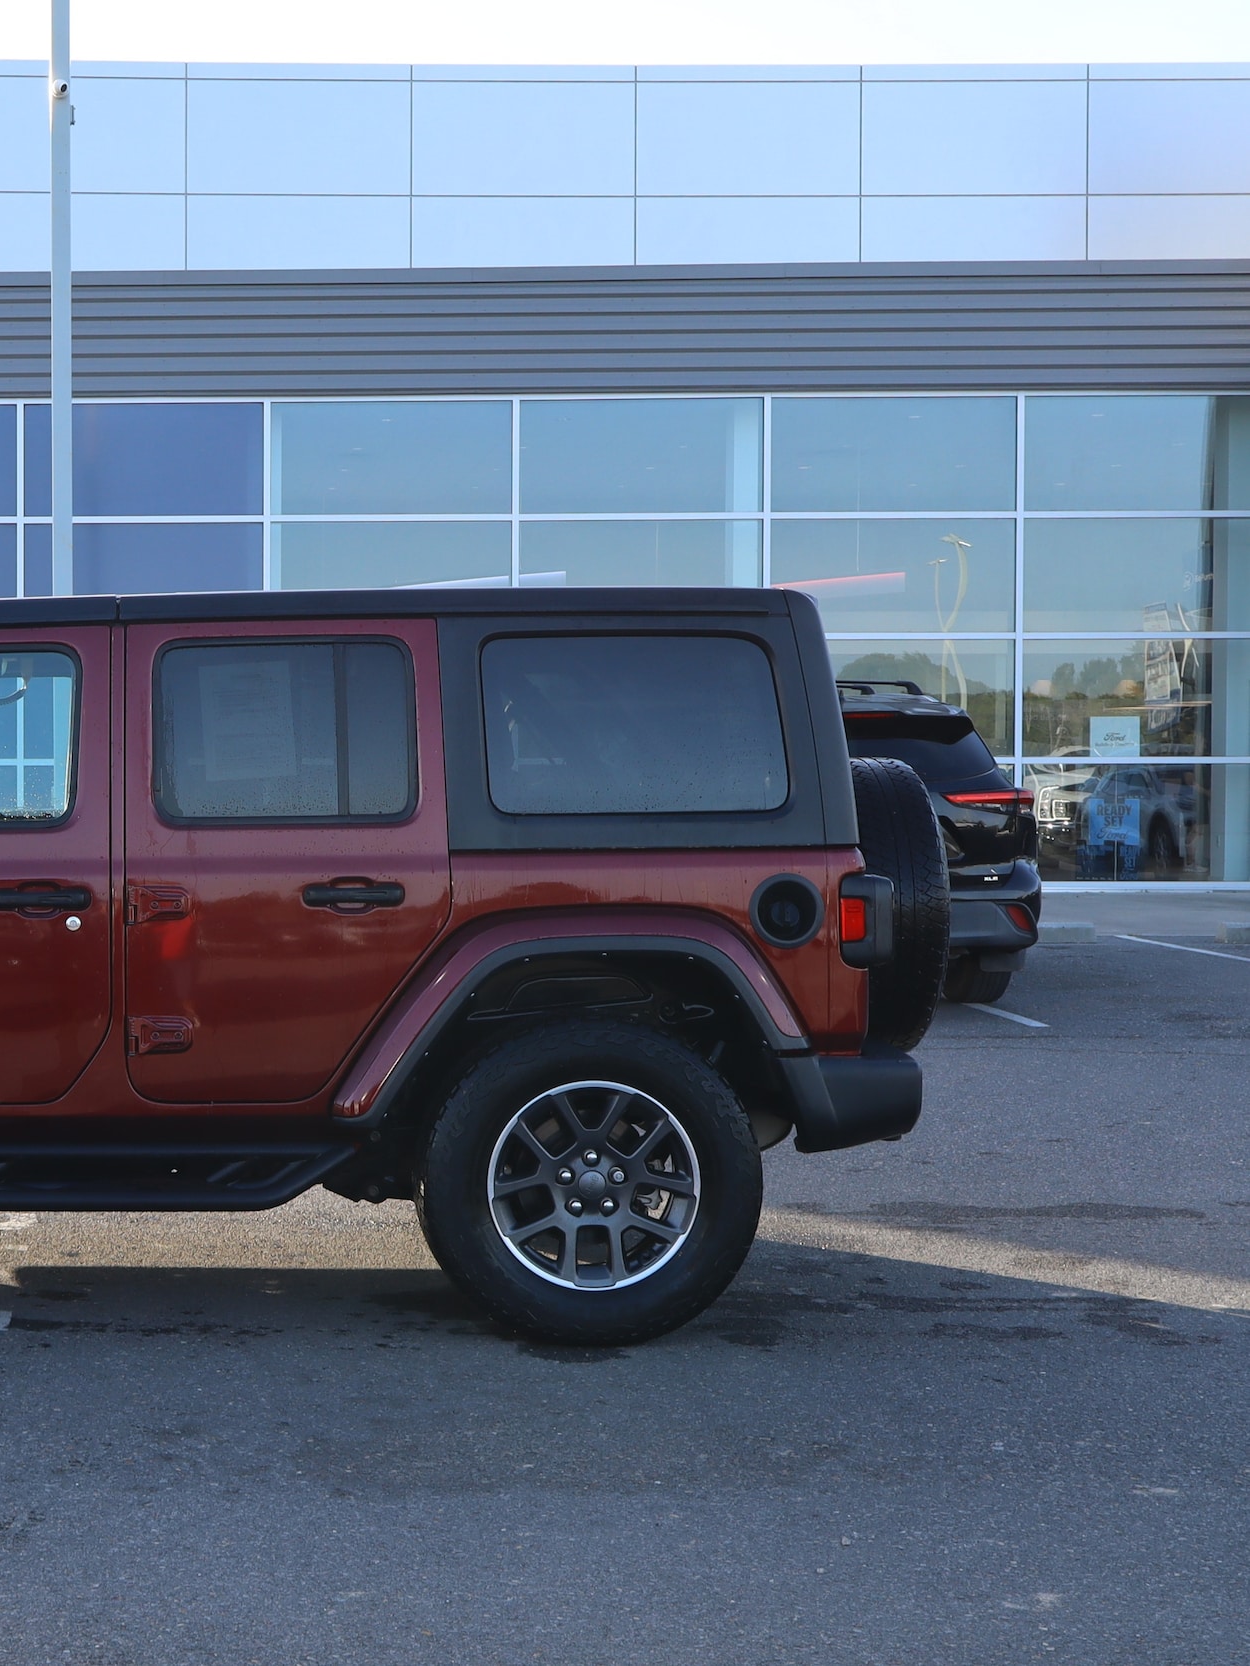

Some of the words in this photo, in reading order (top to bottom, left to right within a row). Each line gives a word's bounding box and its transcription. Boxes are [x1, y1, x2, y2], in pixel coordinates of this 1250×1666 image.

[1103, 732, 1127, 742] Ford
[1096, 804, 1133, 816] READY
[1103, 816, 1124, 828] SET
[1096, 827, 1128, 840] Ford
